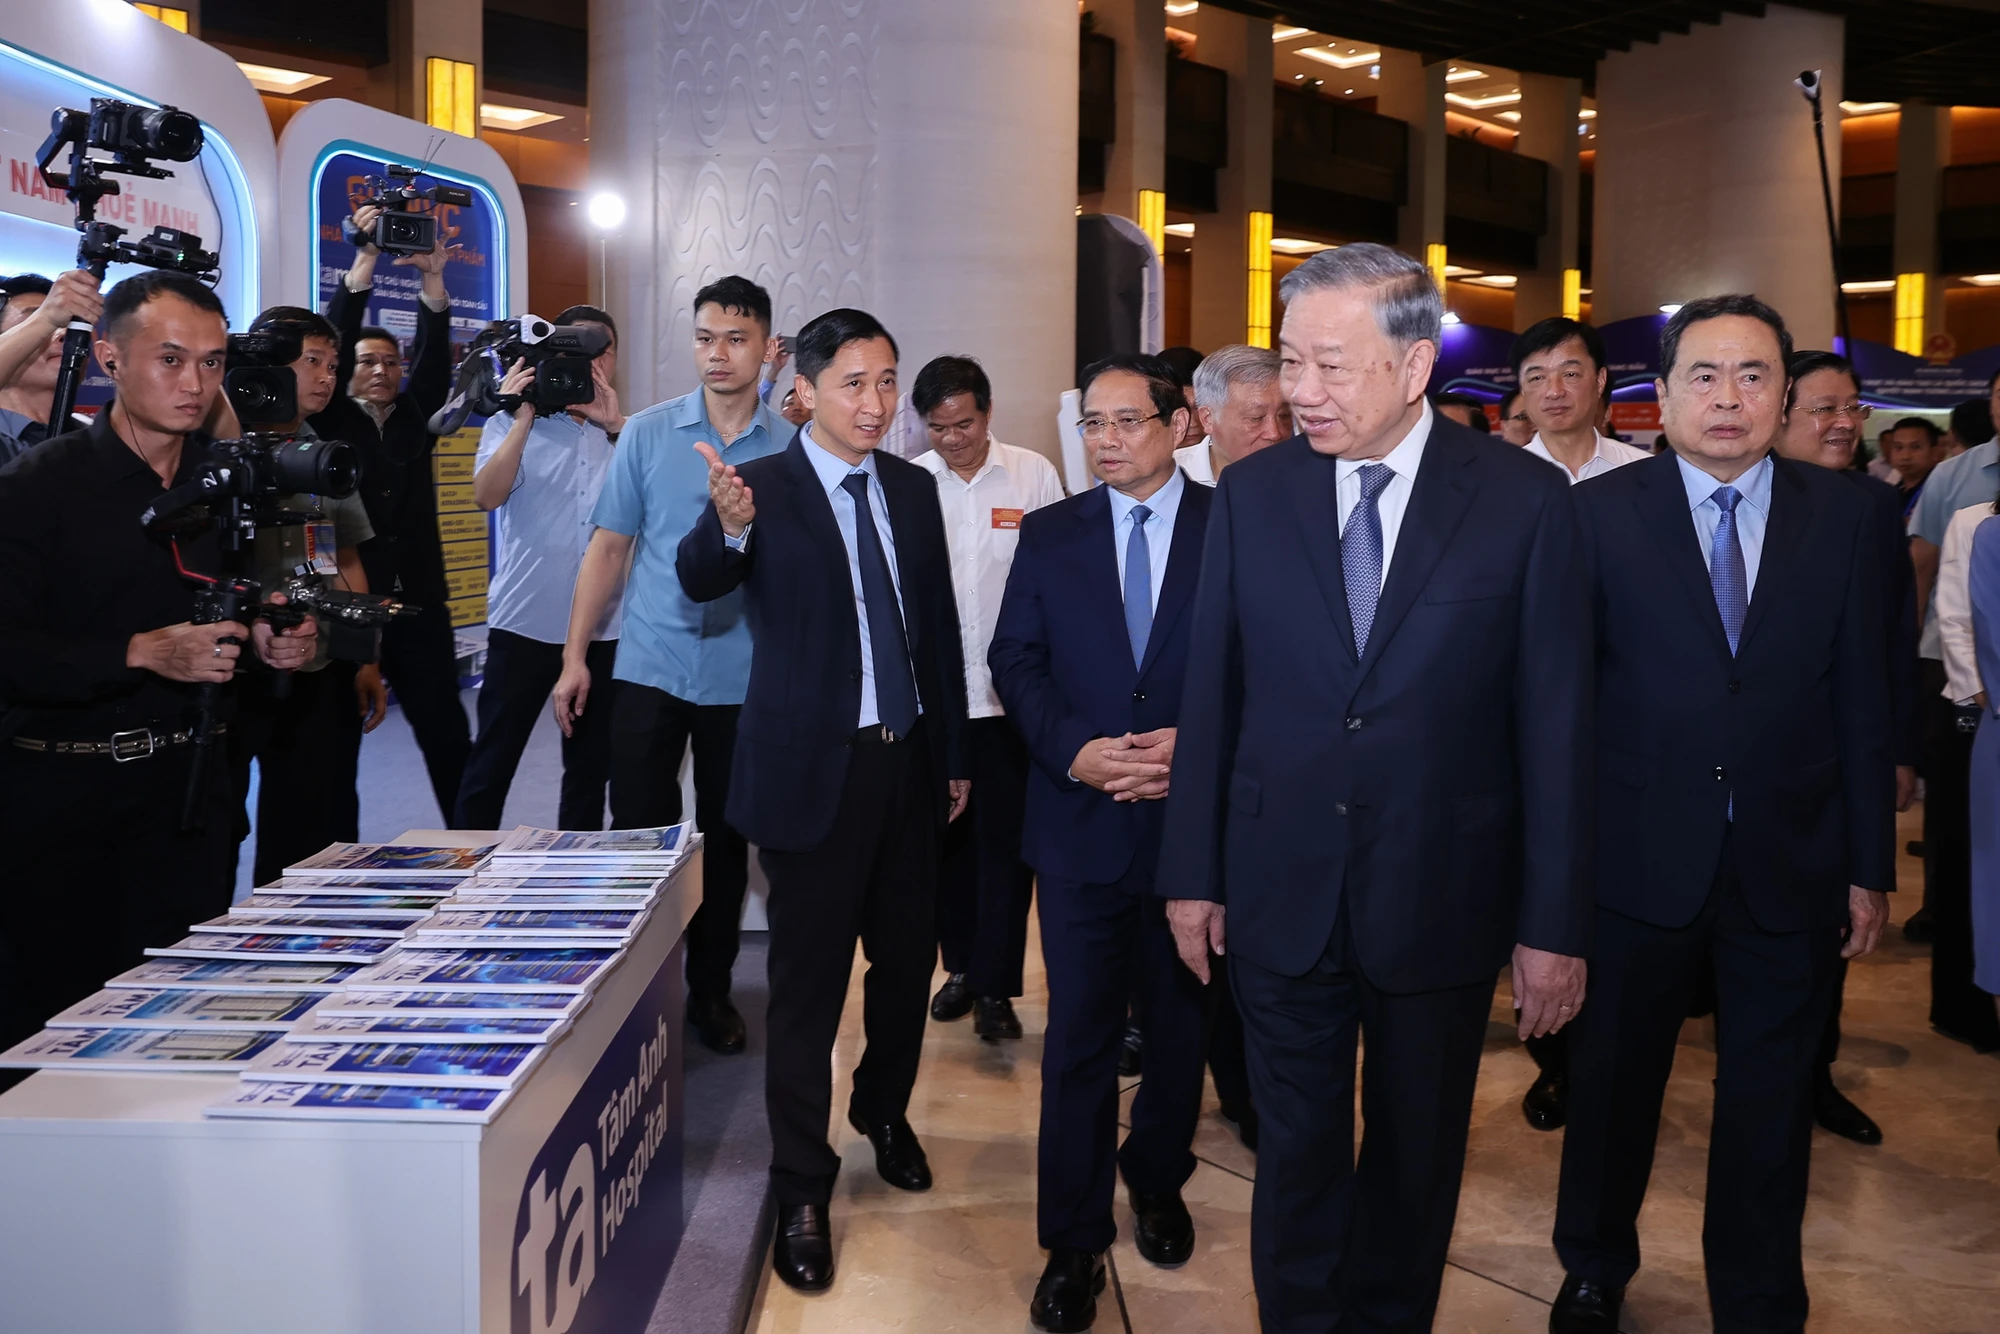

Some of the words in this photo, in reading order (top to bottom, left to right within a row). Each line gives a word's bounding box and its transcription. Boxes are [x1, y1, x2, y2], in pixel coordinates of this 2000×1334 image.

[598, 1076, 637, 1171] Tâm
[637, 1013, 667, 1106] Anh
[601, 1079, 667, 1259] Hospital
[518, 1142, 595, 1334] ta
